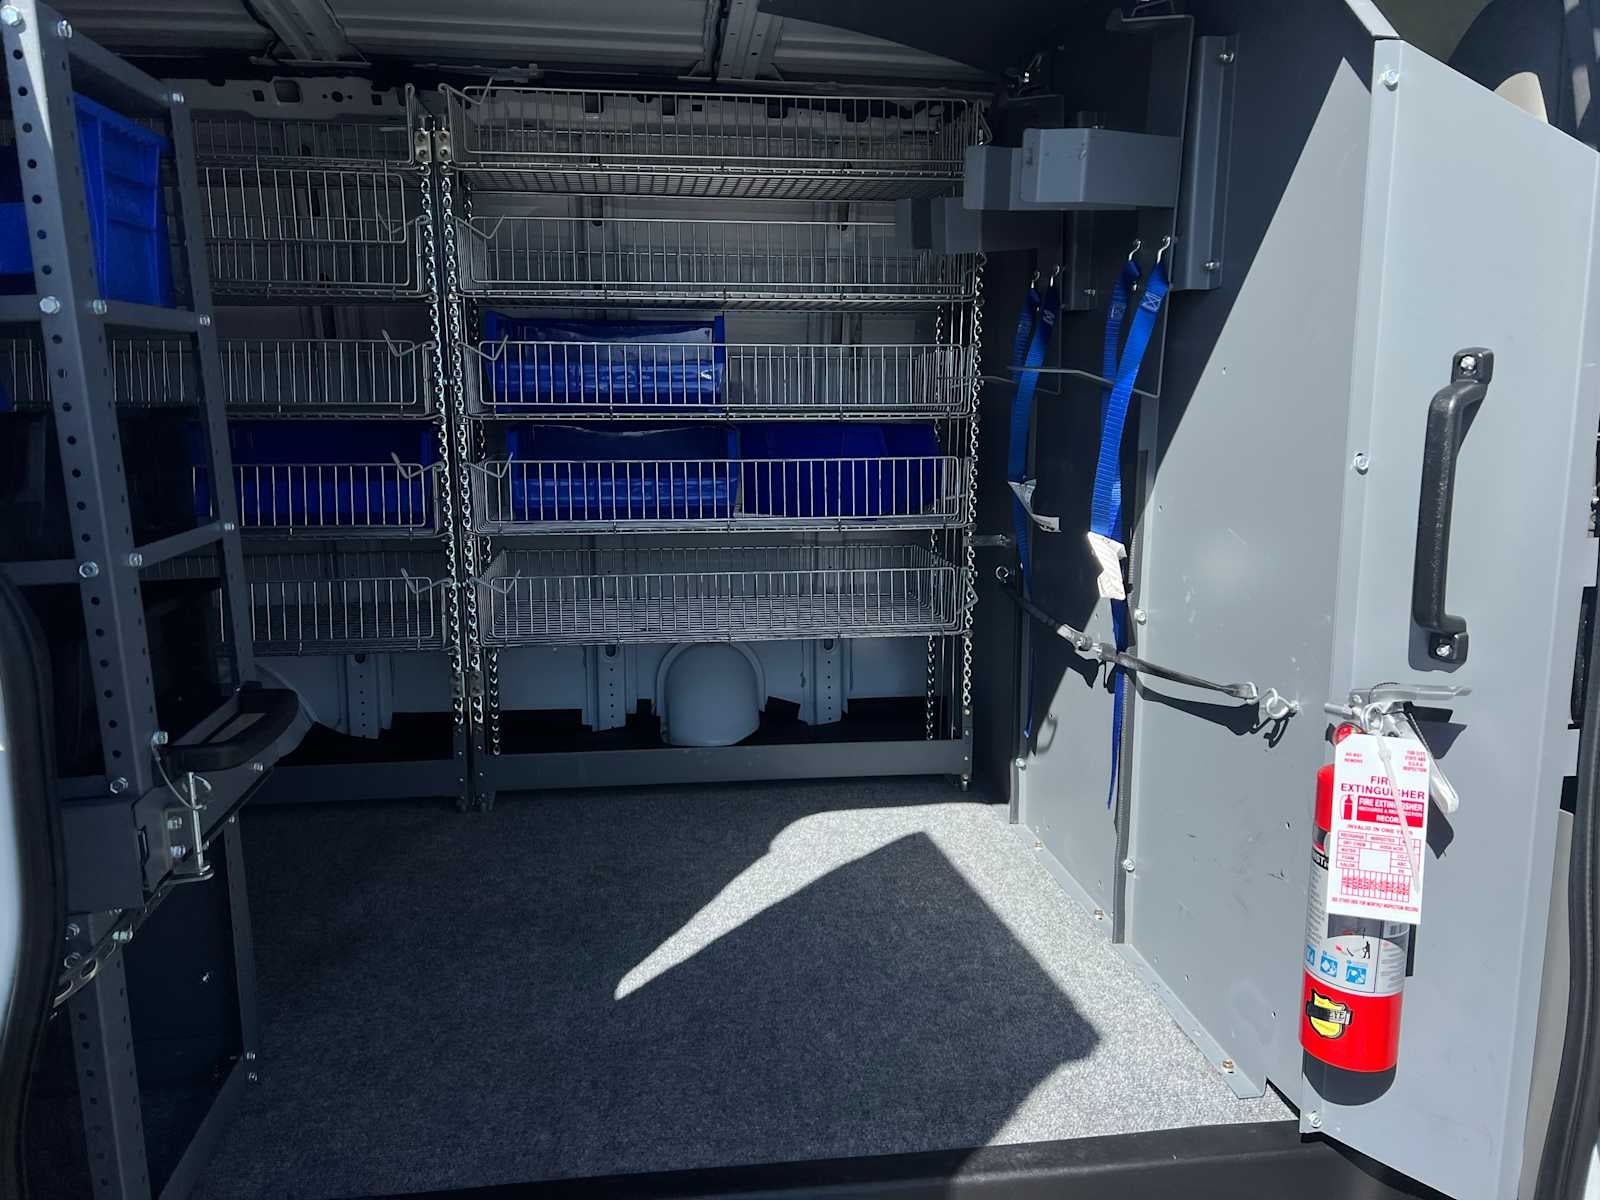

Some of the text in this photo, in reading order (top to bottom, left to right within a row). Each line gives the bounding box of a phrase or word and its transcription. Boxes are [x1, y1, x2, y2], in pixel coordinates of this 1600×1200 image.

[1370, 776, 1393, 786] FIR
[1340, 783, 1425, 800] EXTINGUIHER
[1359, 798, 1423, 812] FIRE EXTINISHER
[1376, 815, 1401, 824] RECOR
